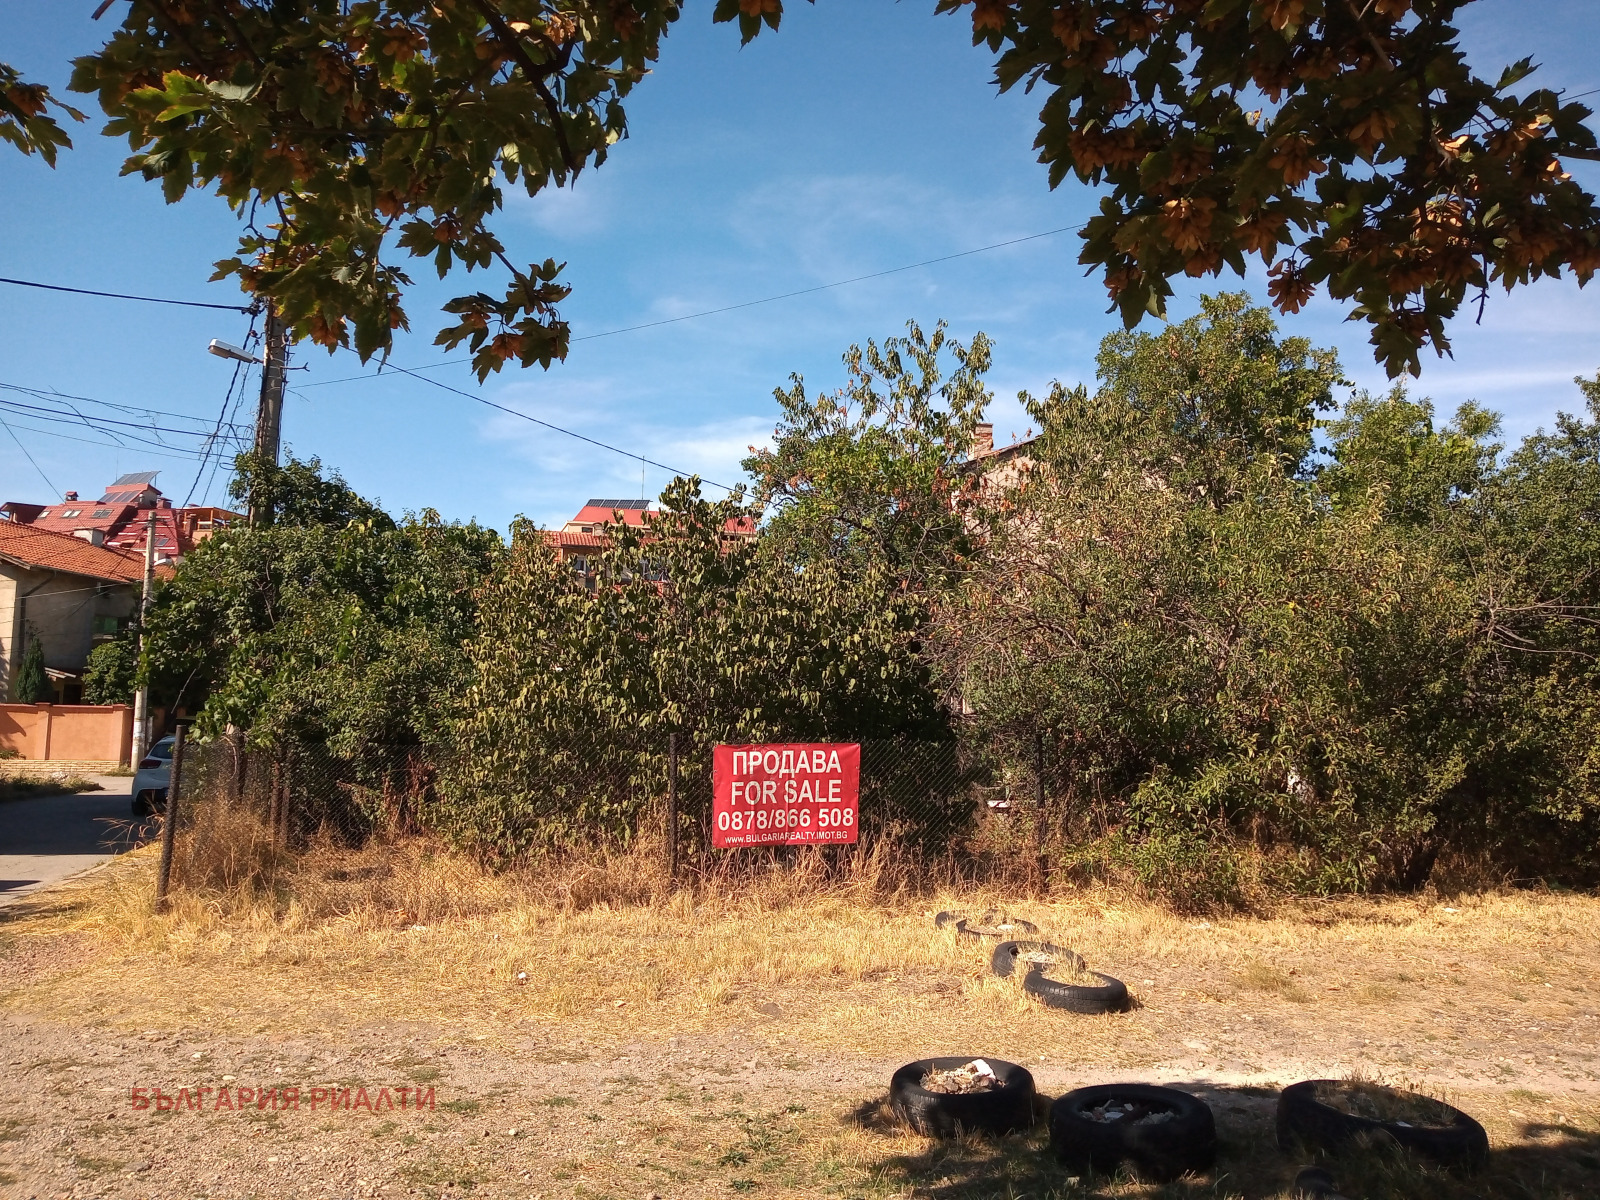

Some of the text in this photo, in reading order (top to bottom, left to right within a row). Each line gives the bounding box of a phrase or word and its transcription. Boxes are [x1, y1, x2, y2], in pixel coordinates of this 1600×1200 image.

[732, 750, 842, 778] ПРОДАВА
[731, 779, 842, 805] FOR SALE
[717, 808, 854, 831] 0878/866 508
